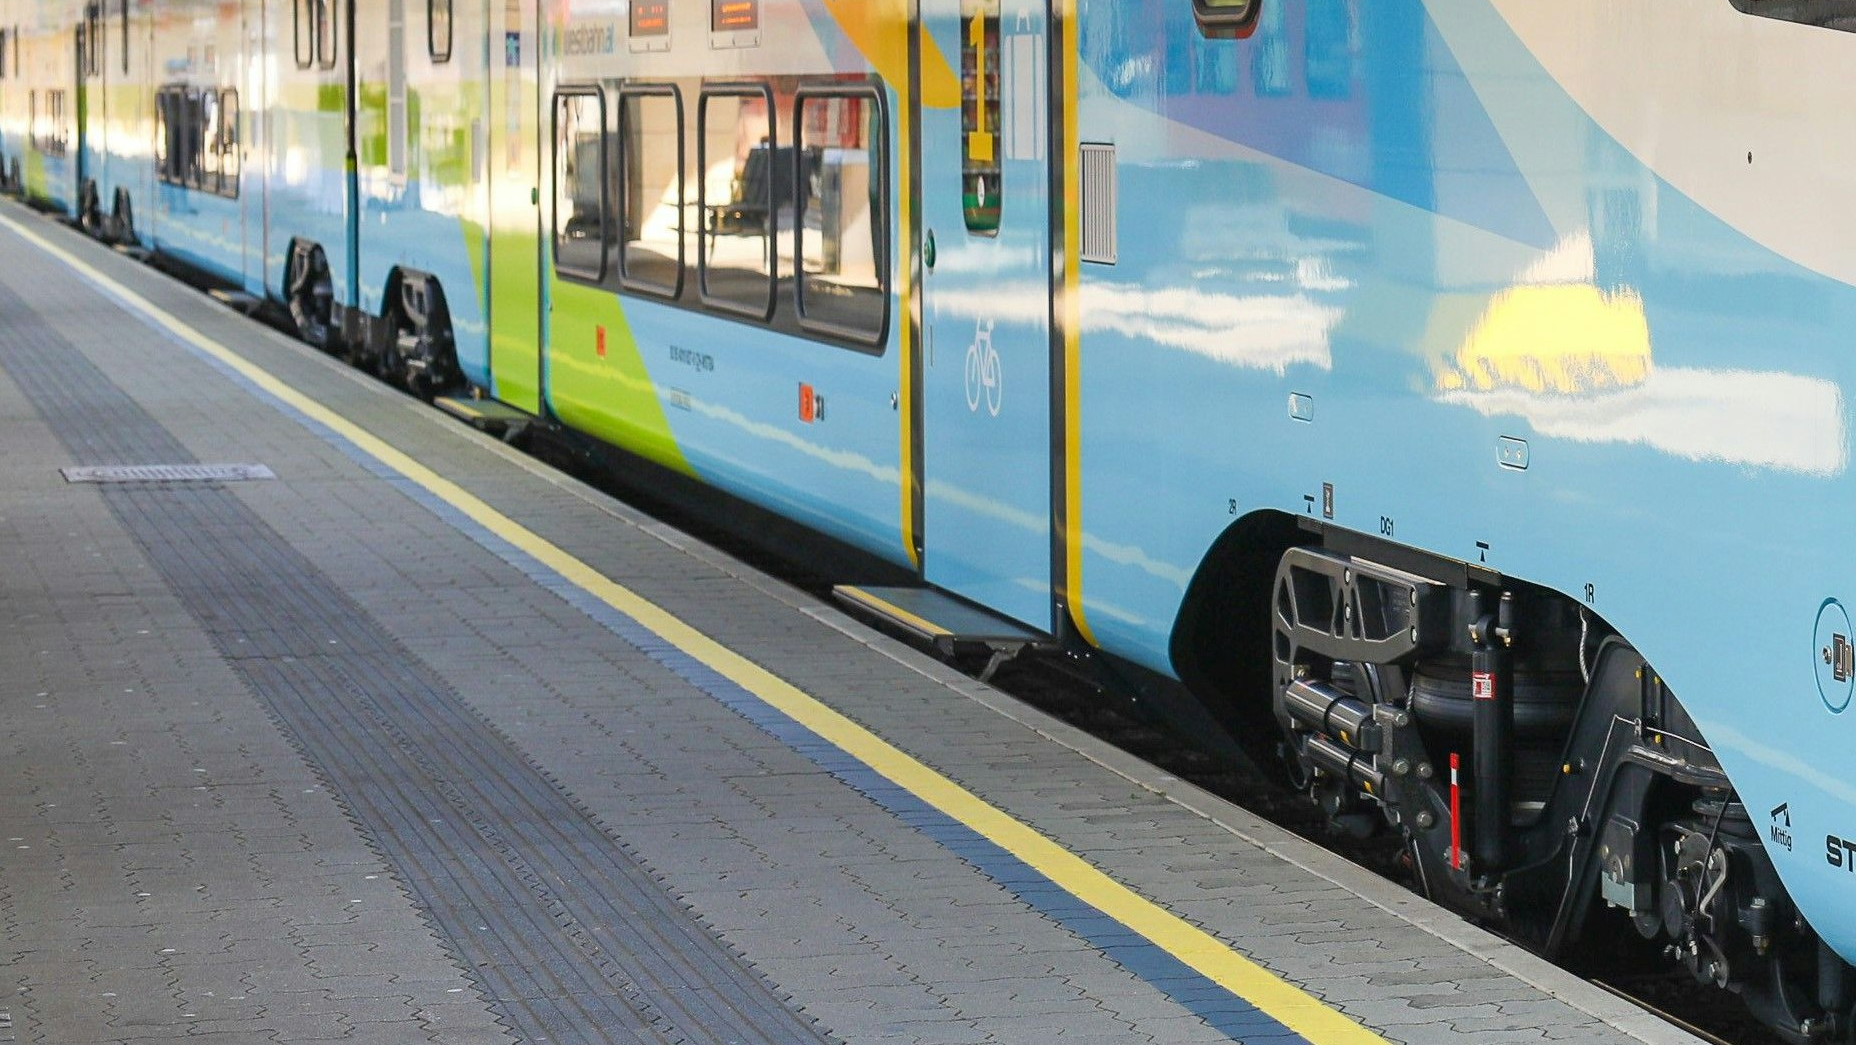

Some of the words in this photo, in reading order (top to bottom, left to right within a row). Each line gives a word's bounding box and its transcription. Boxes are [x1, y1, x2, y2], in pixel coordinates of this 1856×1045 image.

[1380, 516, 1394, 537] DG1
[1584, 583, 1595, 604] 1R
[1770, 825, 1792, 852] Mittig
